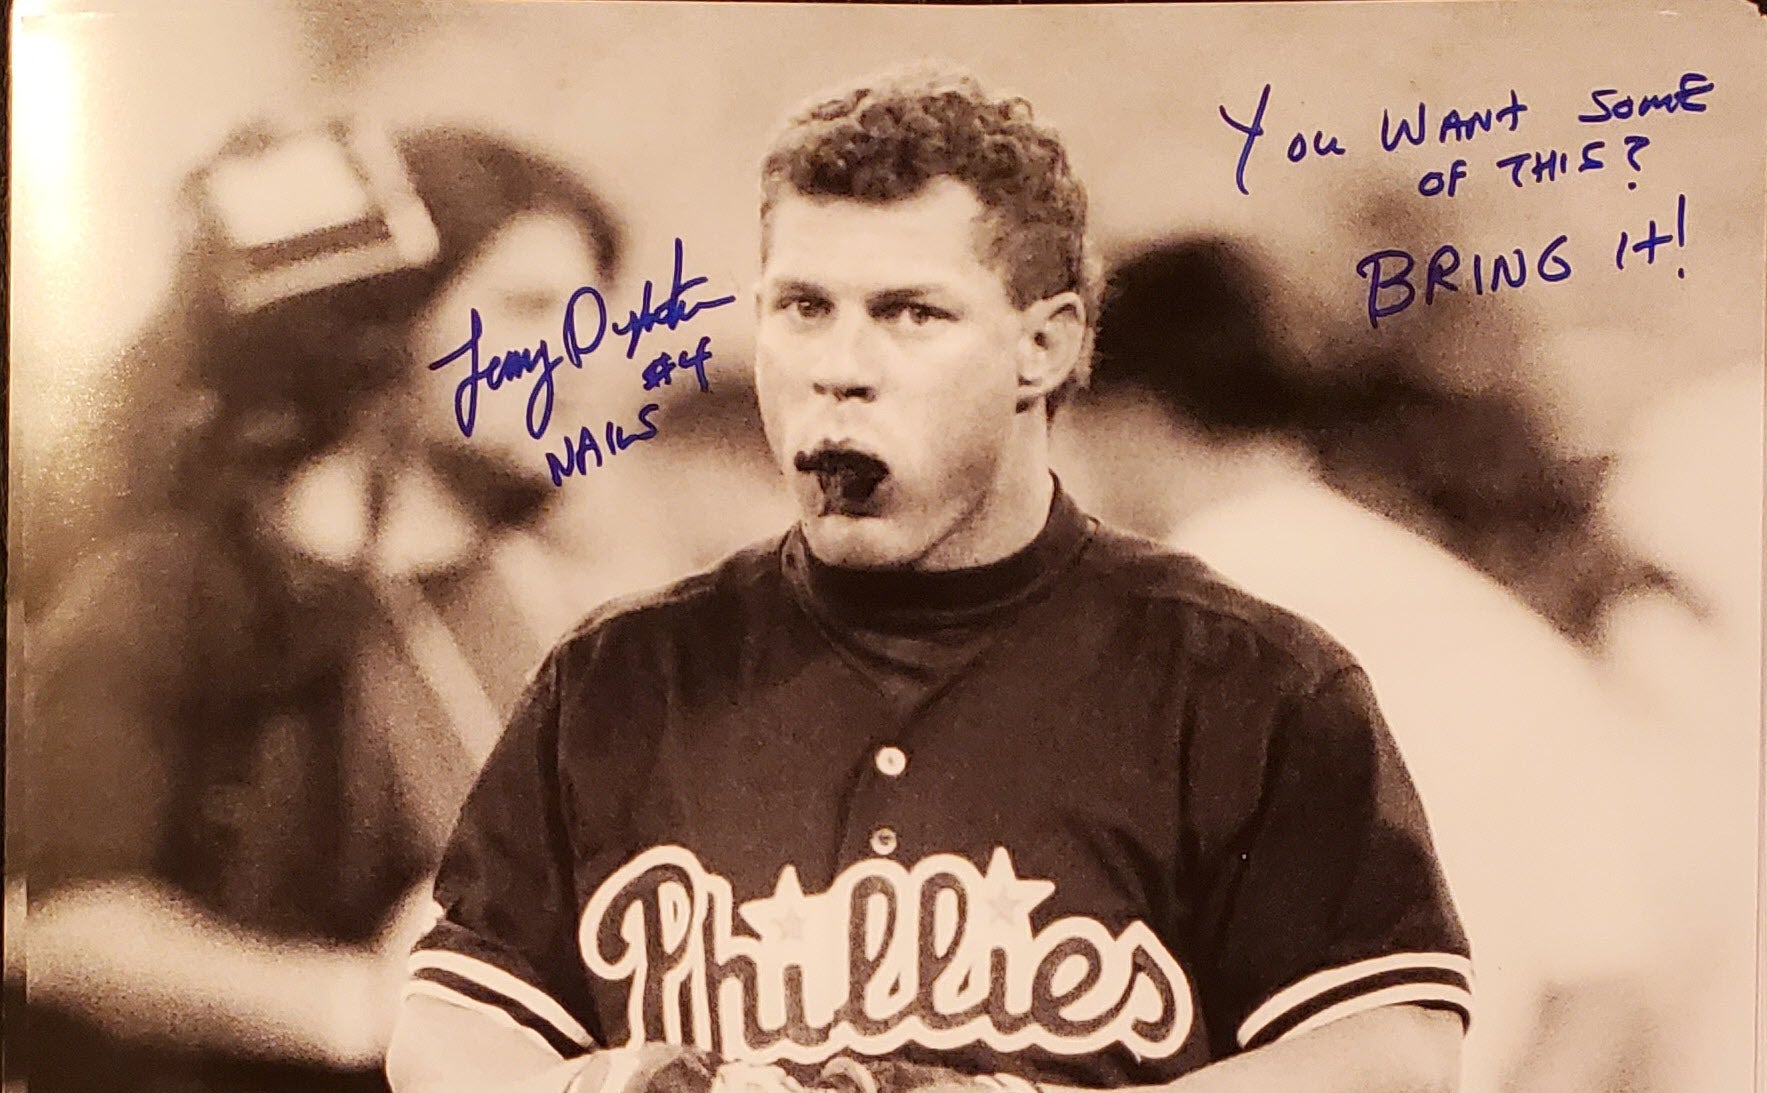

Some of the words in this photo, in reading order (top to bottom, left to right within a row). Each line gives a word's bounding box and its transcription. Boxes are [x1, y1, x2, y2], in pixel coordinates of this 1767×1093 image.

[1418, 159, 1468, 197] OF
[1497, 135, 1651, 191] THIS?
[1356, 234, 1572, 329] BRING
[545, 403, 660, 488] NAILS
[578, 844, 1194, 1064] Phillies
